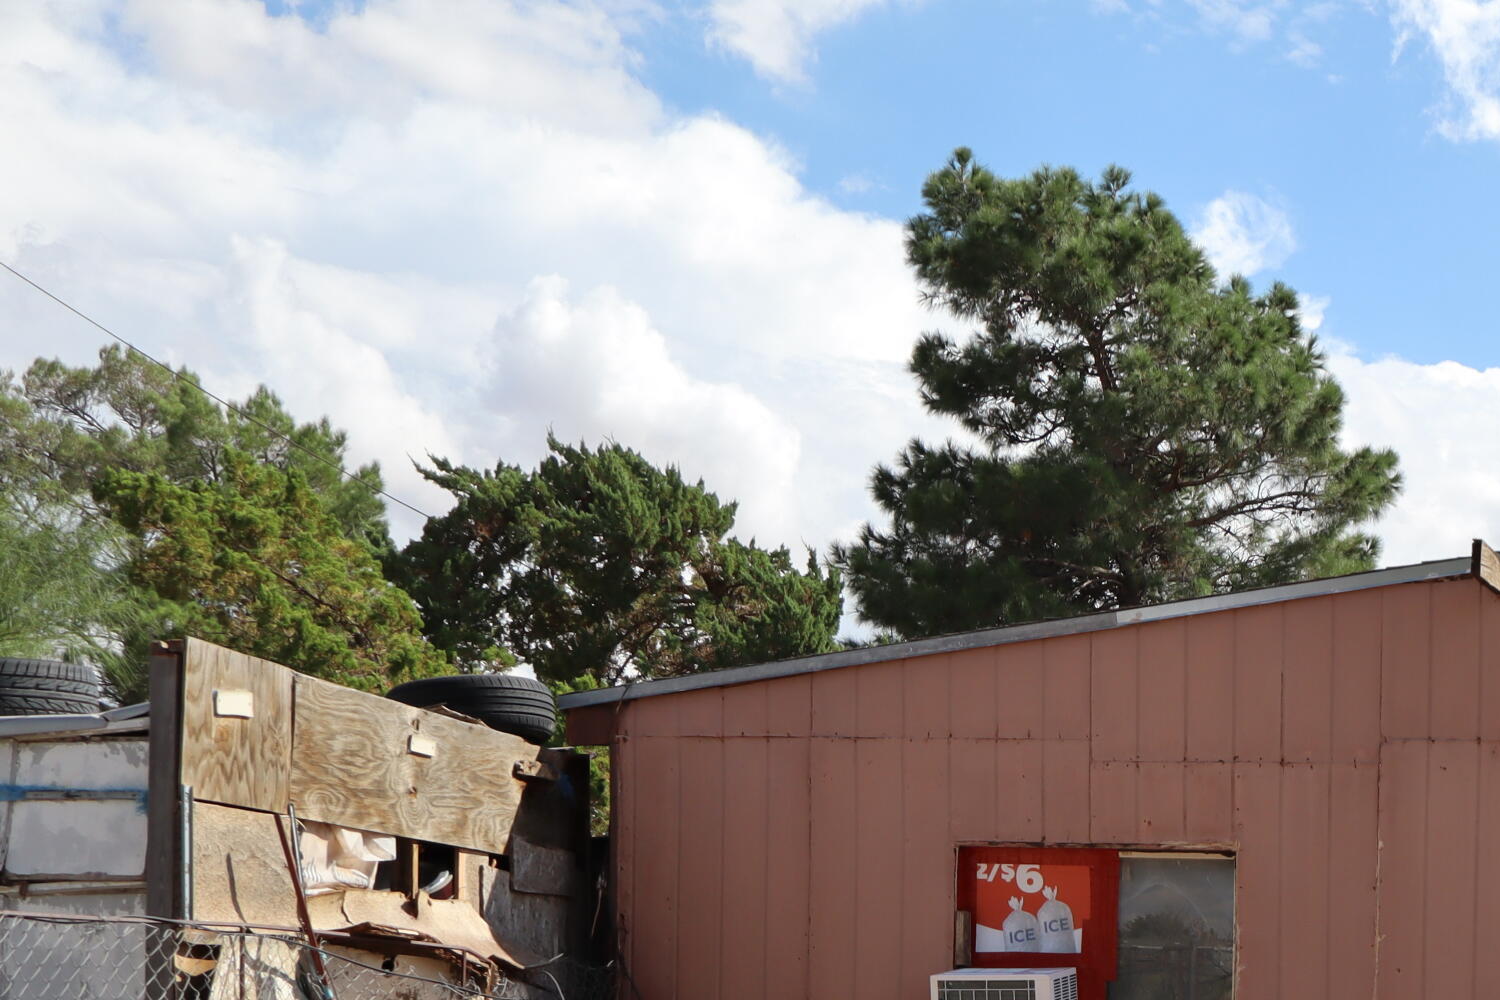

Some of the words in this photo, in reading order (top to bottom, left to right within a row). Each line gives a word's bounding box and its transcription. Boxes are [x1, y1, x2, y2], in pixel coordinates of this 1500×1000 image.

[976, 863, 1044, 893] 2/$6
[1043, 918, 1070, 933] ICE
[1009, 928, 1036, 943] ICE
